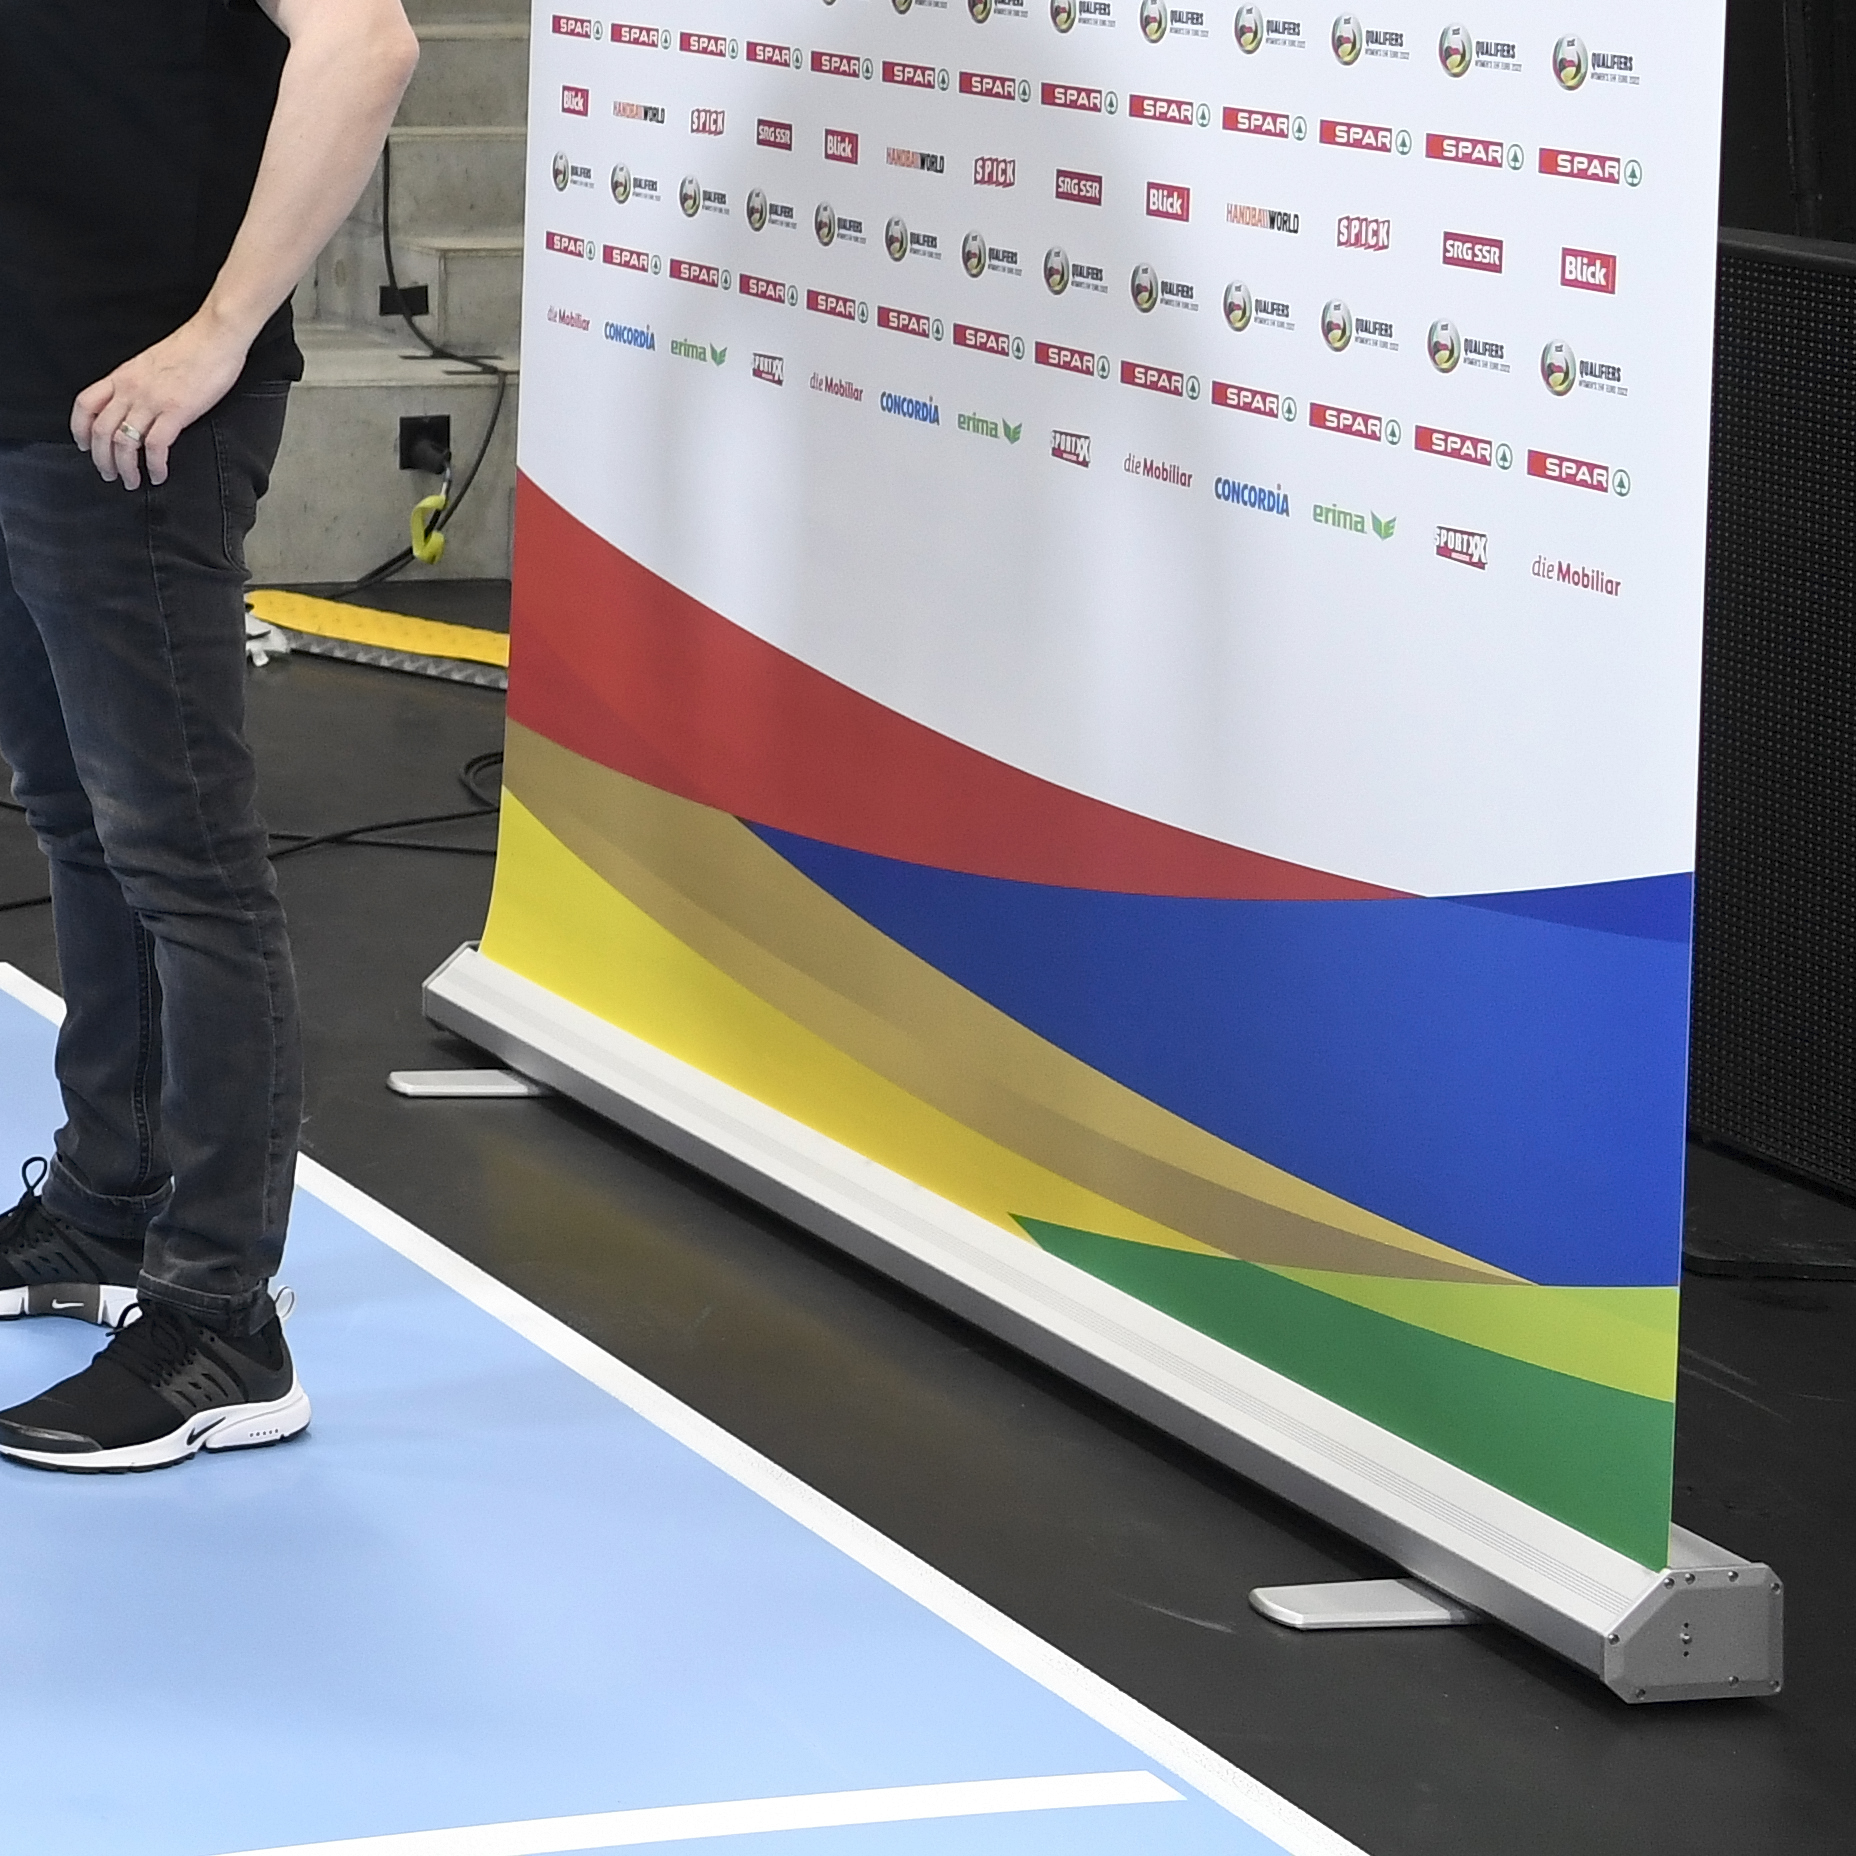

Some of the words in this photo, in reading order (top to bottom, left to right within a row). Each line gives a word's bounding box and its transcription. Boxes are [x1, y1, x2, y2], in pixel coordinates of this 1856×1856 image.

[560, 20, 591, 36] SPAR
[1054, 88, 1101, 108] SPAR
[1142, 100, 1193, 120] SPAR
[1237, 112, 1288, 133] SPAR
[1334, 126, 1390, 148] SPAR
[1442, 140, 1502, 164] SPAR
[1556, 154, 1620, 178] SPAR
[1058, 176, 1078, 196] SRG
[1080, 179, 1100, 200] SSR
[1150, 188, 1182, 214] Blick
[1338, 216, 1388, 247] SPICK
[553, 236, 584, 254] SPAR
[1446, 241, 1472, 262] SRG
[1473, 244, 1500, 265] SSR
[1564, 256, 1606, 286] Blick
[1048, 348, 1094, 372] SPAR
[1134, 368, 1182, 392] SPAR
[1226, 388, 1278, 413] SPAR
[1325, 410, 1381, 436] SPAR
[1431, 433, 1490, 460] SPAR
[1124, 454, 1142, 474] die
[1143, 458, 1192, 487] Mobiliar
[1544, 458, 1608, 487] SPAR
[1312, 504, 1366, 534] erima
[1532, 555, 1554, 580] die
[1557, 559, 1621, 596] Mobiliar
